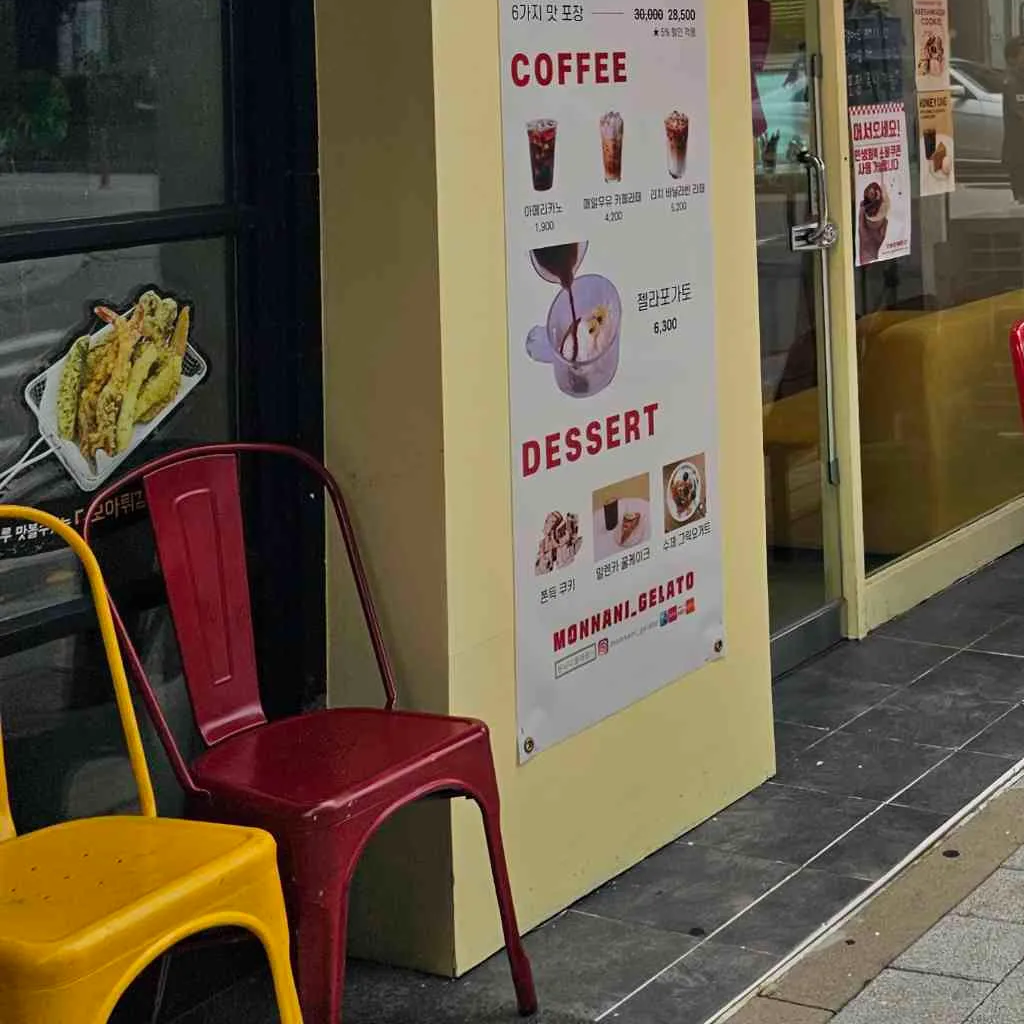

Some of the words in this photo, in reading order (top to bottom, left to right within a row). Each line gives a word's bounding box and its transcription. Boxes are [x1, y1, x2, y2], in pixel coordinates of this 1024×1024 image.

[512, 4, 542, 22] 6가지
[546, 4, 558, 22] 맛
[560, 5, 584, 22] 포장
[668, 9, 696, 22] 28,500
[511, 51, 627, 87] COFFEE
[853, 119, 900, 141] 어서오세요!
[524, 200, 564, 218] 아메리카노
[535, 220, 555, 232] 1,900
[653, 317, 678, 335] 6,300
[522, 402, 659, 477] DESSERT
[554, 571, 695, 653] MONNANI_GELATO
